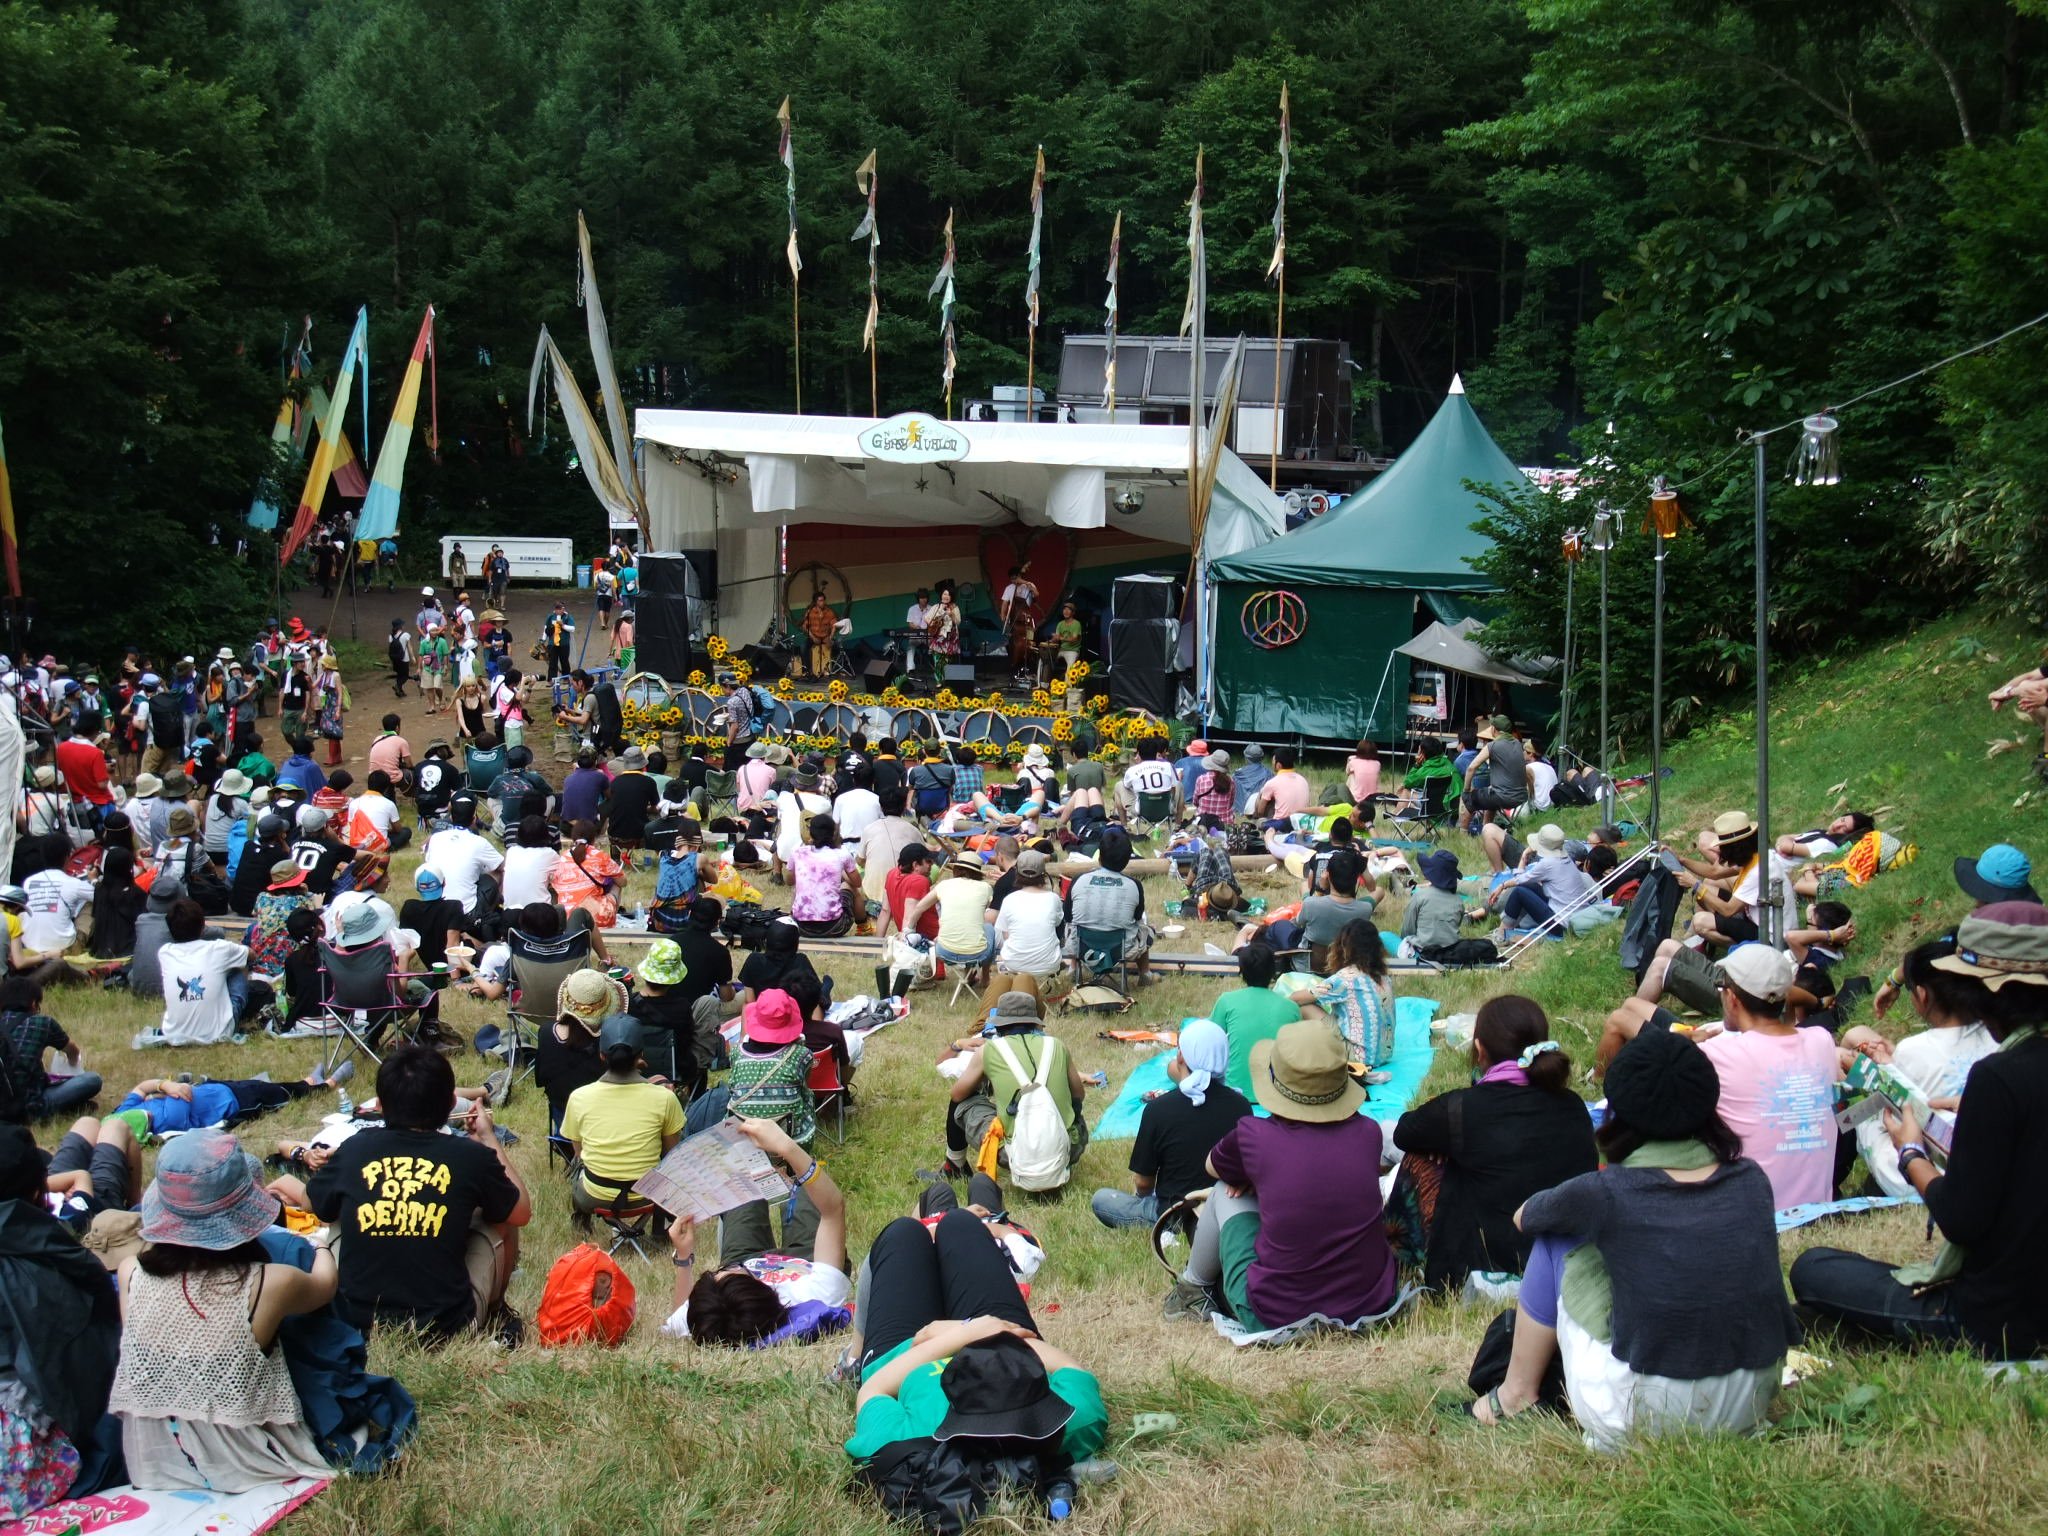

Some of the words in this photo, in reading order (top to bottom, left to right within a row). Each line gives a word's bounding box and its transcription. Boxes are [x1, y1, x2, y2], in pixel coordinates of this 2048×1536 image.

[1140, 771, 1163, 790] 10
[362, 1156, 451, 1195] PIZZA
[382, 1179, 424, 1201] OF
[358, 1199, 448, 1237] DEATH
